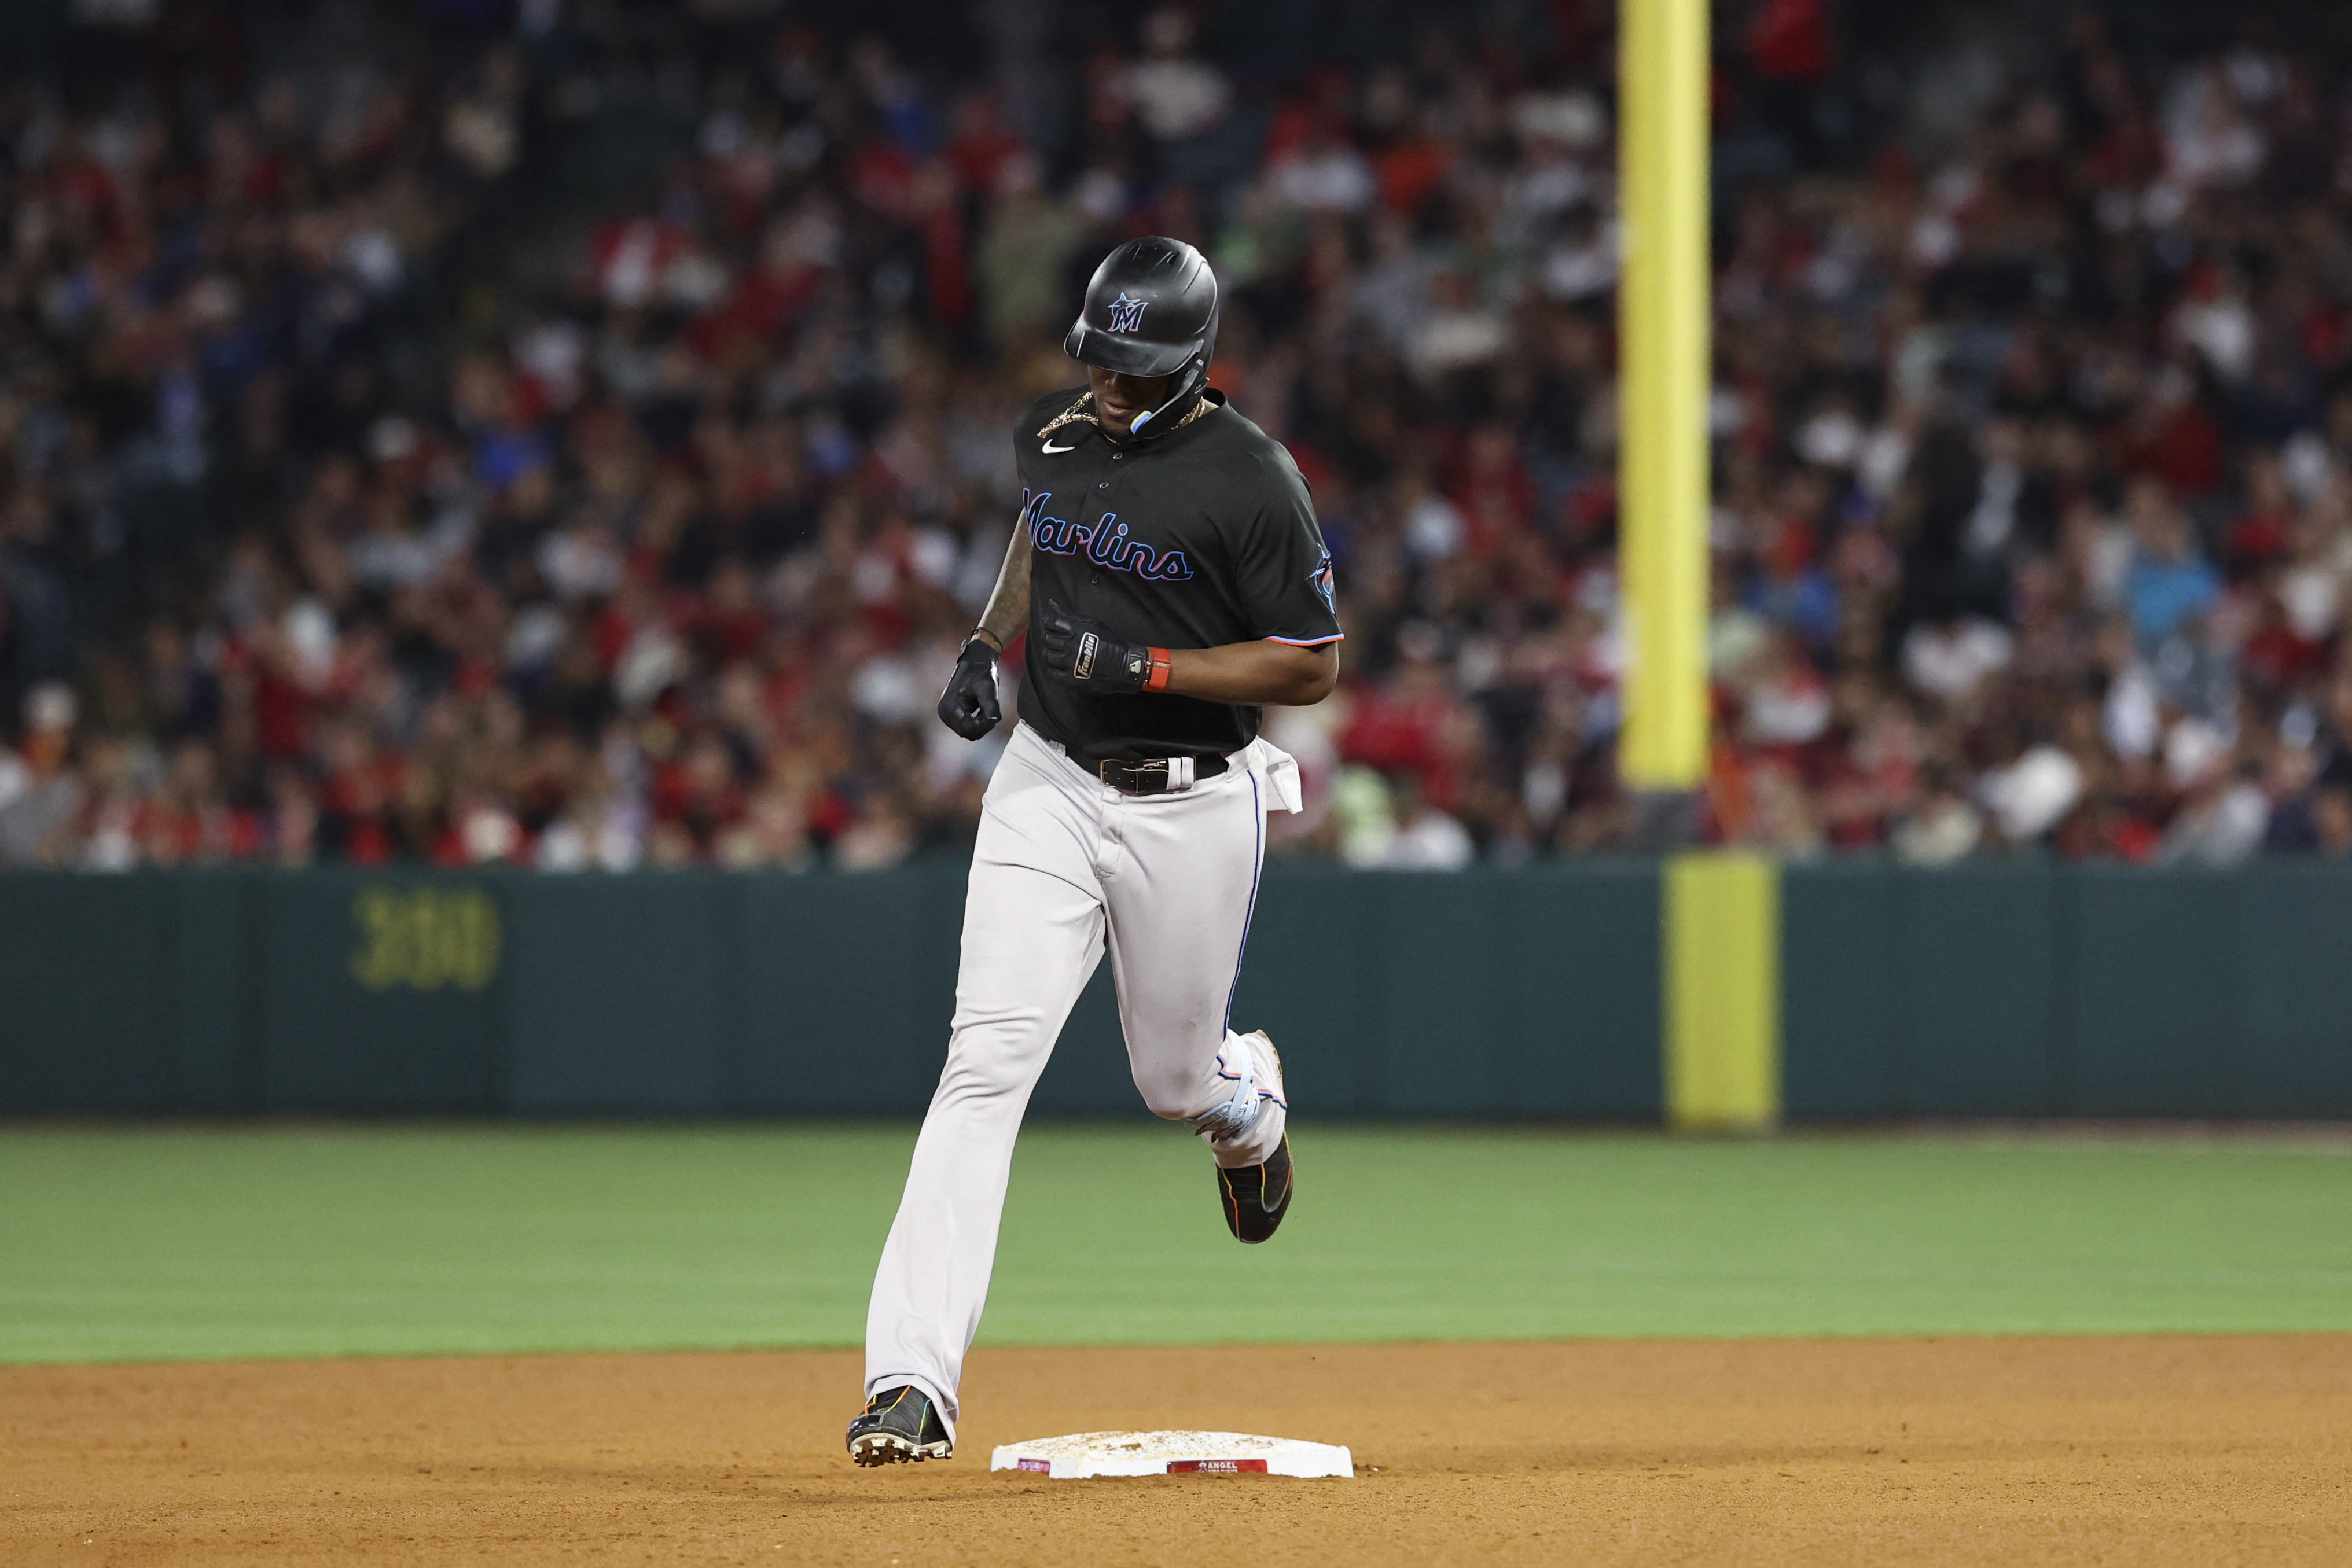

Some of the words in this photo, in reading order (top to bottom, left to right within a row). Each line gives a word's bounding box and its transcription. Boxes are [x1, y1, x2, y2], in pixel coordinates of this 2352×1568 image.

[1023, 487, 1194, 581] Marlins
[1077, 636, 1095, 677] Franklin
[1207, 1461, 1238, 1469] ANGEL
